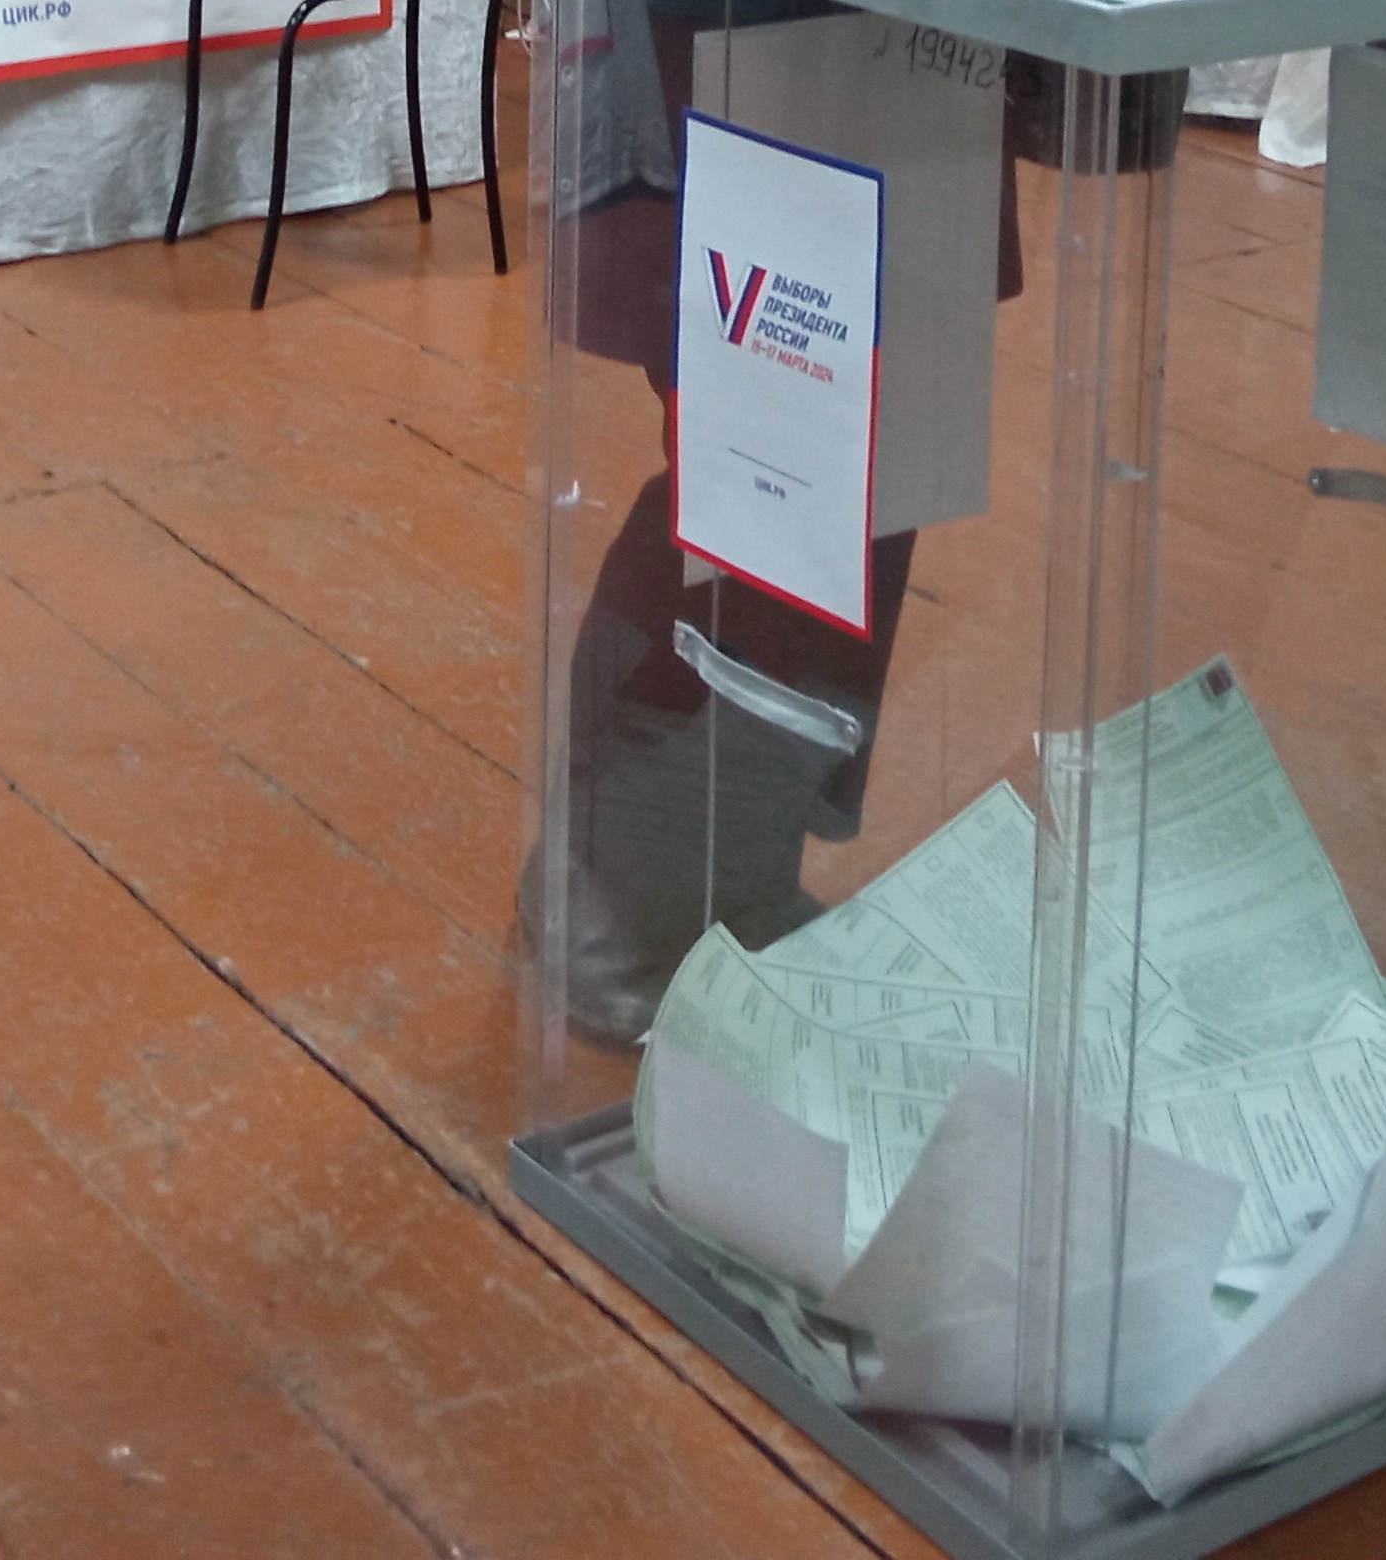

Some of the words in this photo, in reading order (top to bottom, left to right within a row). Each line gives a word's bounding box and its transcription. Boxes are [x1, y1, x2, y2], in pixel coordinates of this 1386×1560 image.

[2, 0, 72, 26] ЦИК.РФ
[771, 273, 833, 310] ВЫБОРЫ
[756, 318, 811, 352] РОССИИ
[763, 296, 848, 343] ПРЕЗИДЕНТА
[776, 348, 810, 376] МАРТА
